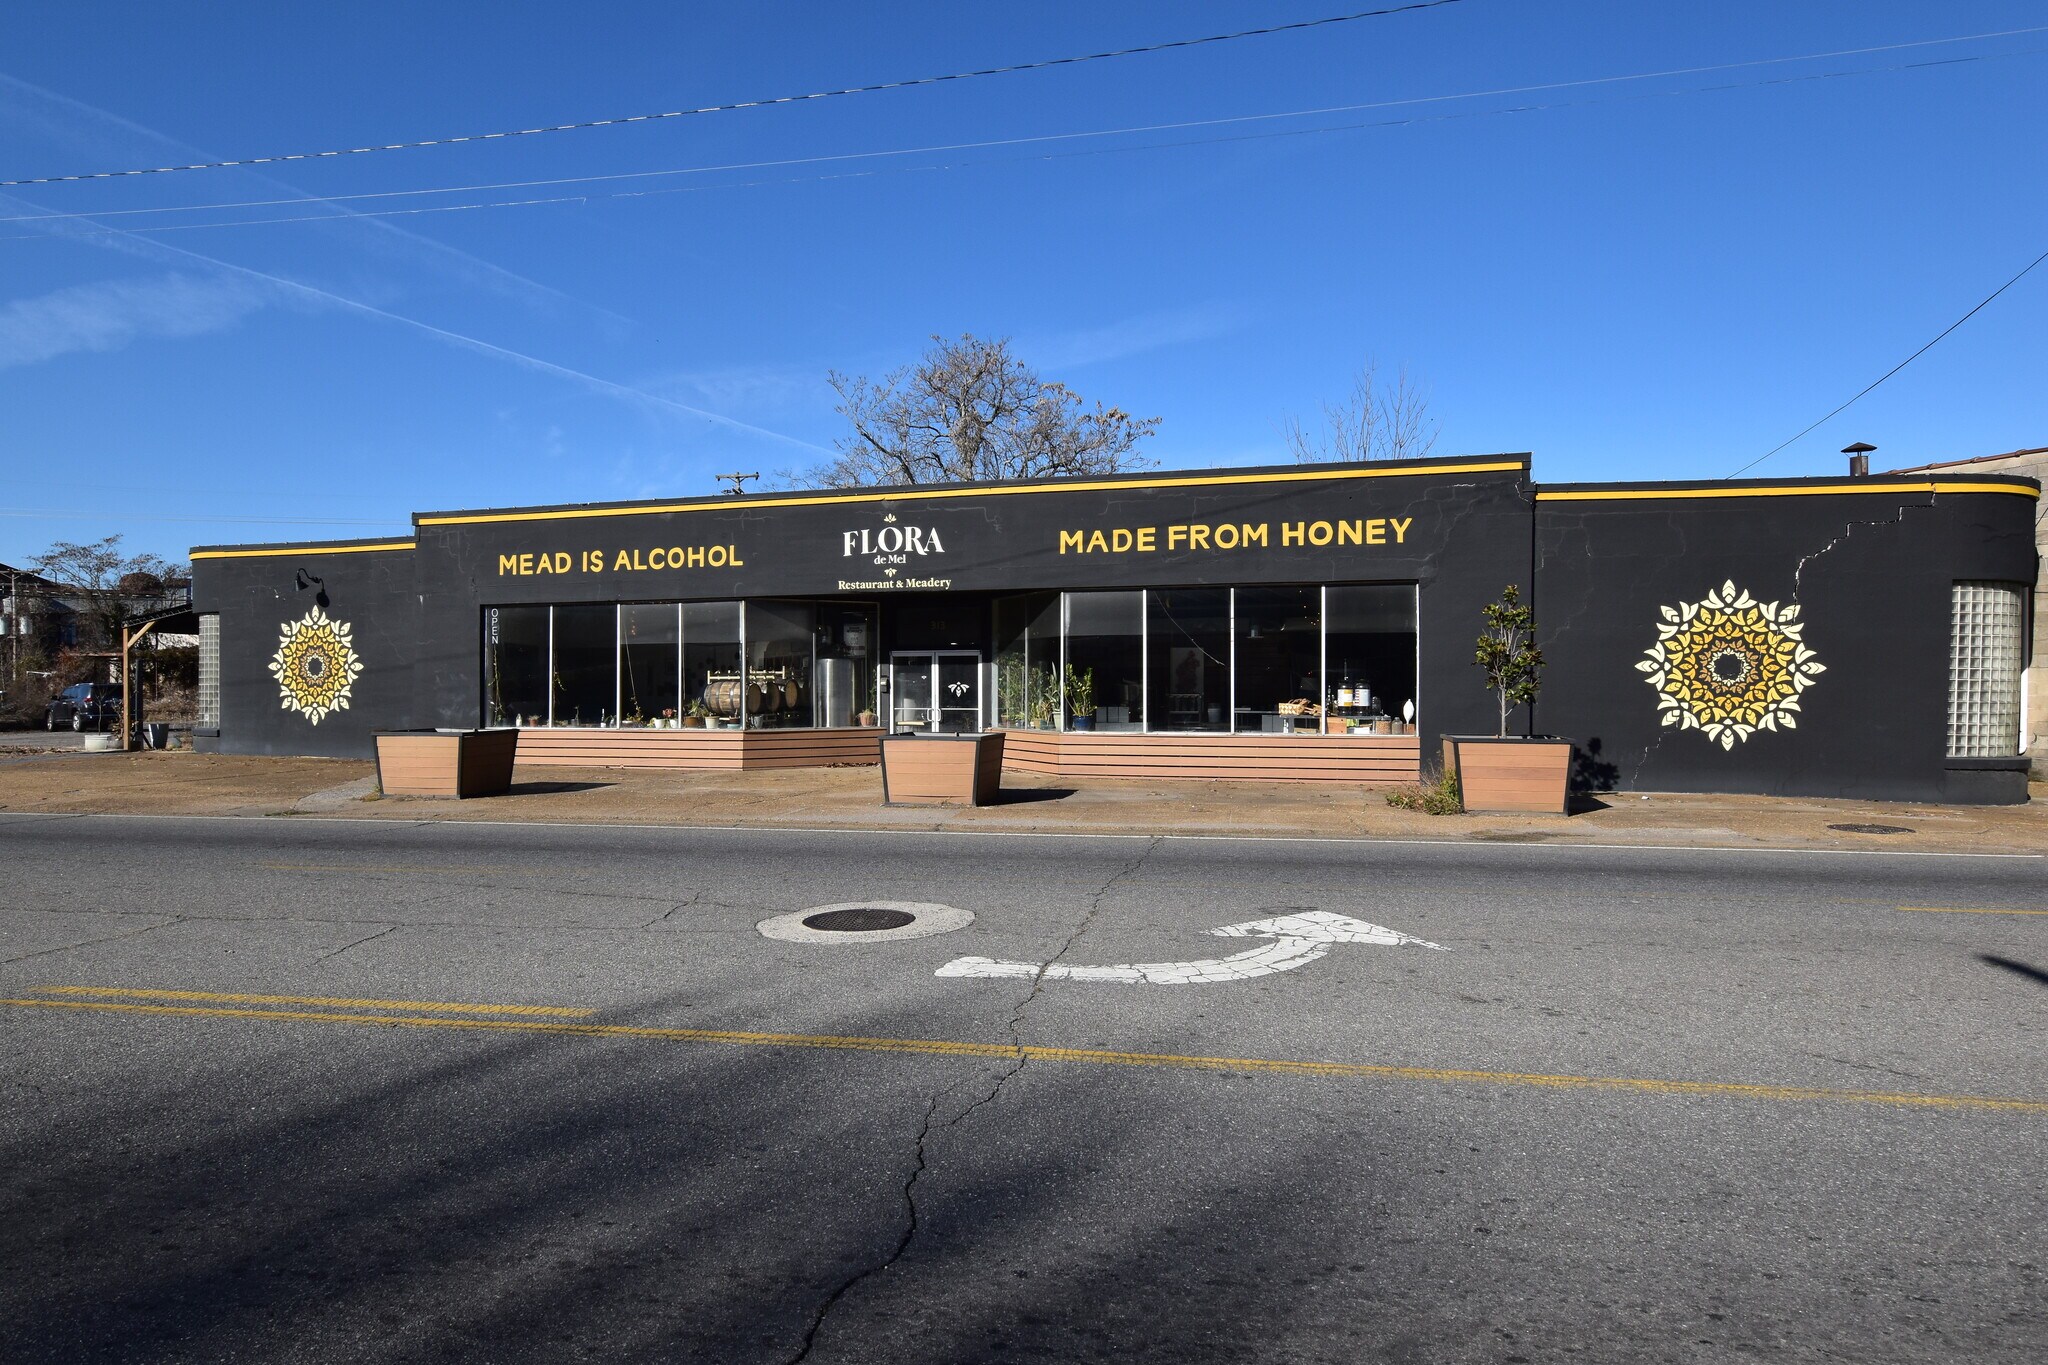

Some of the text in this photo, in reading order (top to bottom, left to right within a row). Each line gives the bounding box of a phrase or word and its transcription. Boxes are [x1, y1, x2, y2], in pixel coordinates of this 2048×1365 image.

[843, 526, 945, 557] FLORA
[1059, 517, 1413, 555] MADE FROM HONEY
[498, 544, 744, 576] MEAD IS ALCOHOL
[874, 554, 907, 565] de Mel
[838, 577, 952, 590] Restaurant & Meadery
[491, 608, 499, 644] OPEN
